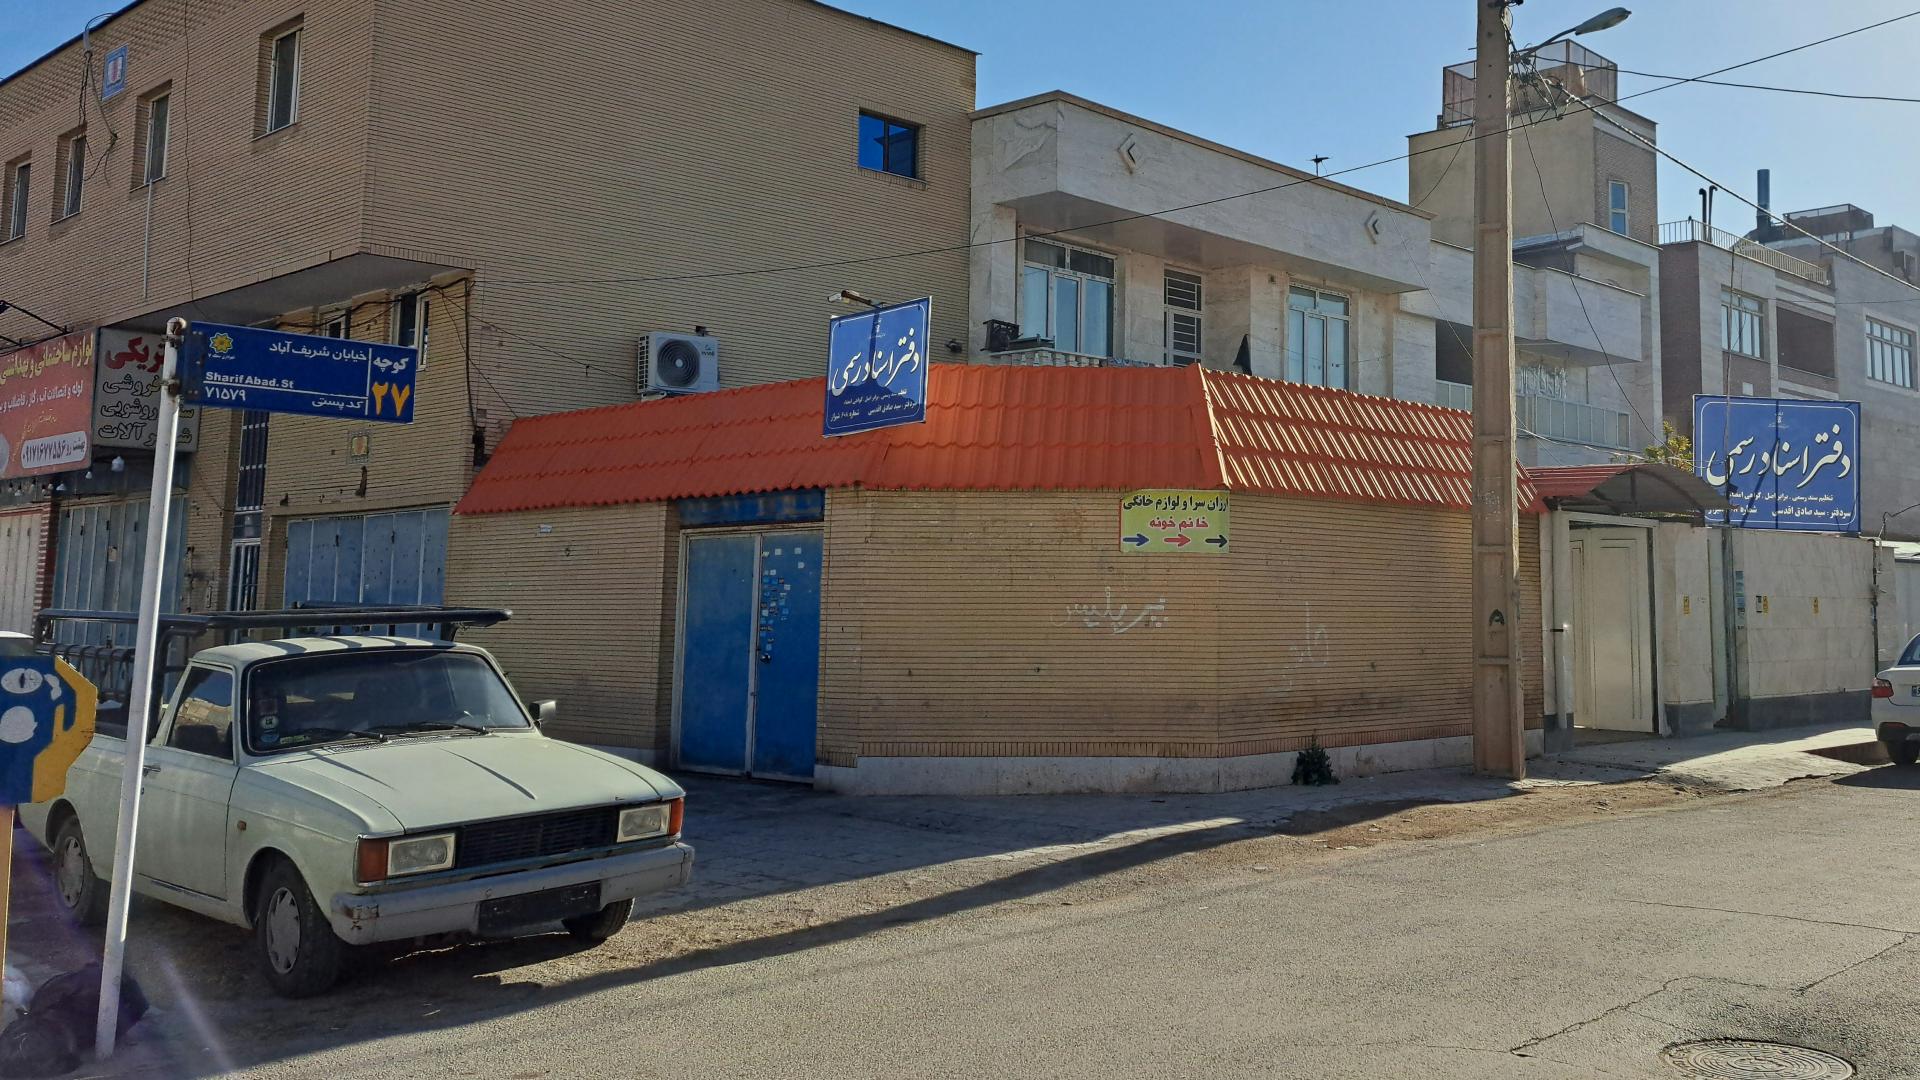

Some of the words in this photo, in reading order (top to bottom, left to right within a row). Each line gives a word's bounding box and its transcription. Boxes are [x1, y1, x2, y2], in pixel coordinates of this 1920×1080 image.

[71, 332, 94, 368] لوازم
[269, 341, 293, 355] آباد
[292, 345, 330, 359] شریف
[331, 348, 367, 363] خیابان
[373, 356, 409, 374] کوچه
[884, 327, 920, 387] دفتر
[831, 351, 862, 396] رسمی
[861, 350, 894, 382] اسناد
[205, 371, 245, 384] Sharif
[281, 379, 295, 389] St
[205, 386, 246, 401] ۷۱۵۷۹
[371, 381, 411, 417] ۲۷
[312, 397, 345, 411] پستی
[345, 400, 364, 409] کد
[98, 421, 147, 440] آلات
[1706, 436, 1755, 486] رسمی
[1758, 440, 1808, 476] اسناد
[1796, 424, 1851, 488] دفتر
[1123, 494, 1154, 510] خانگی
[1155, 495, 1180, 511] لوازم
[1181, 499, 1188, 511] و
[1189, 495, 1206, 511] سرا
[1207, 495, 1229, 512] ارزان
[1771, 505, 1794, 517] اقدسی
[1794, 506, 1813, 517] صادق
[1813, 508, 1826, 517] سید
[1149, 516, 1176, 530] خونه
[1178, 516, 1209, 532] خانم
